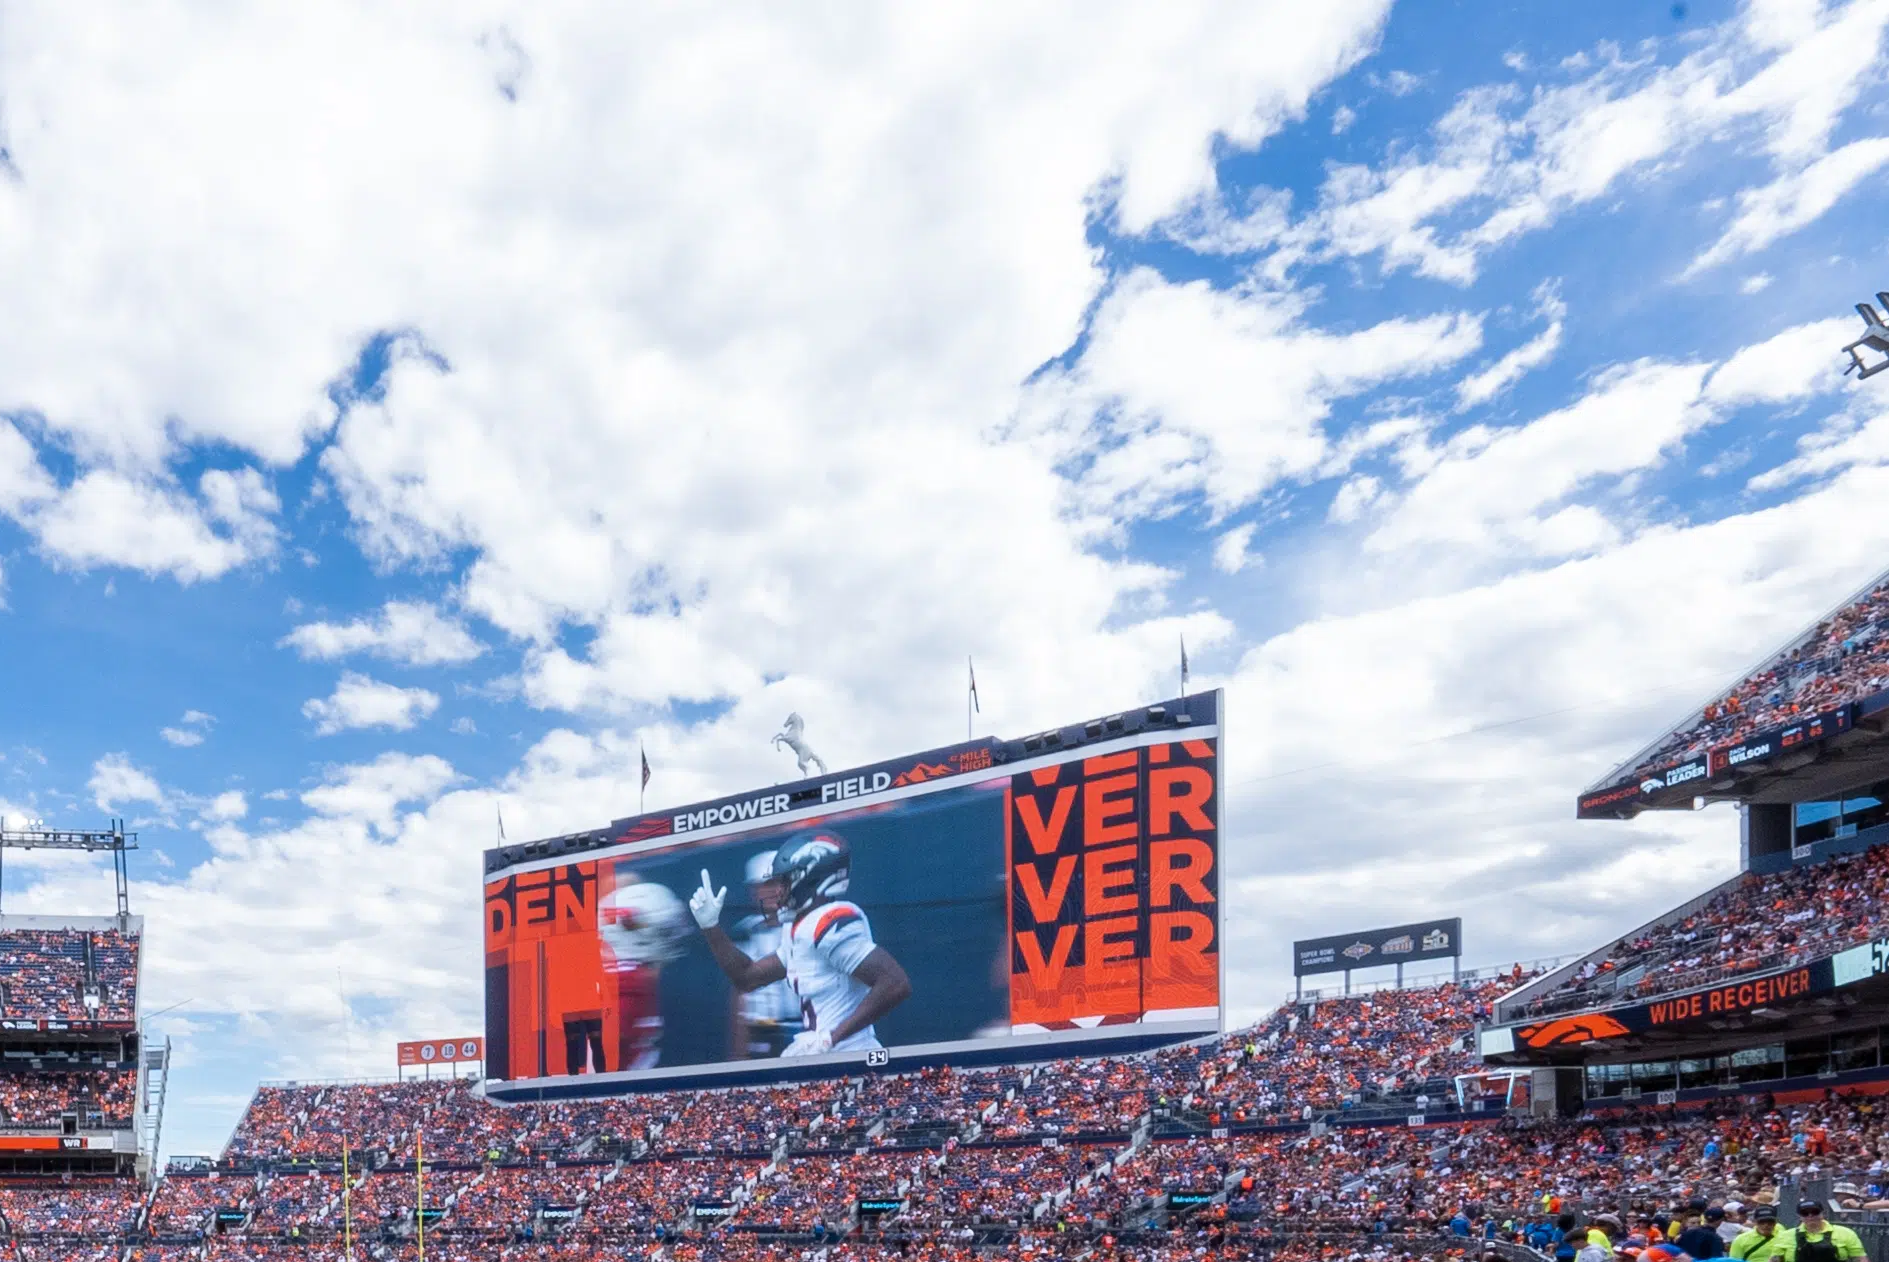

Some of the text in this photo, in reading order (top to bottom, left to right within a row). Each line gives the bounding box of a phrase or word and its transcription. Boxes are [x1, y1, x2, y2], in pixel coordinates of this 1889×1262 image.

[959, 747, 990, 762] MILE
[959, 758, 991, 772] HIGH
[1729, 744, 1770, 765] WILSON
[1667, 766, 1706, 787] LEADER
[673, 795, 790, 834] EMPOWER
[821, 771, 891, 803] FIELD
[1583, 785, 1639, 808] BRONCOS
[1014, 765, 1216, 855] VER
[1014, 838, 1216, 924] VER
[1015, 910, 1216, 992] VER
[1648, 967, 1810, 1025] WIDE RECEIVER
[464, 1043, 475, 1055] 44
[870, 1051, 886, 1065] 34
[63, 1138, 80, 1148] WR
